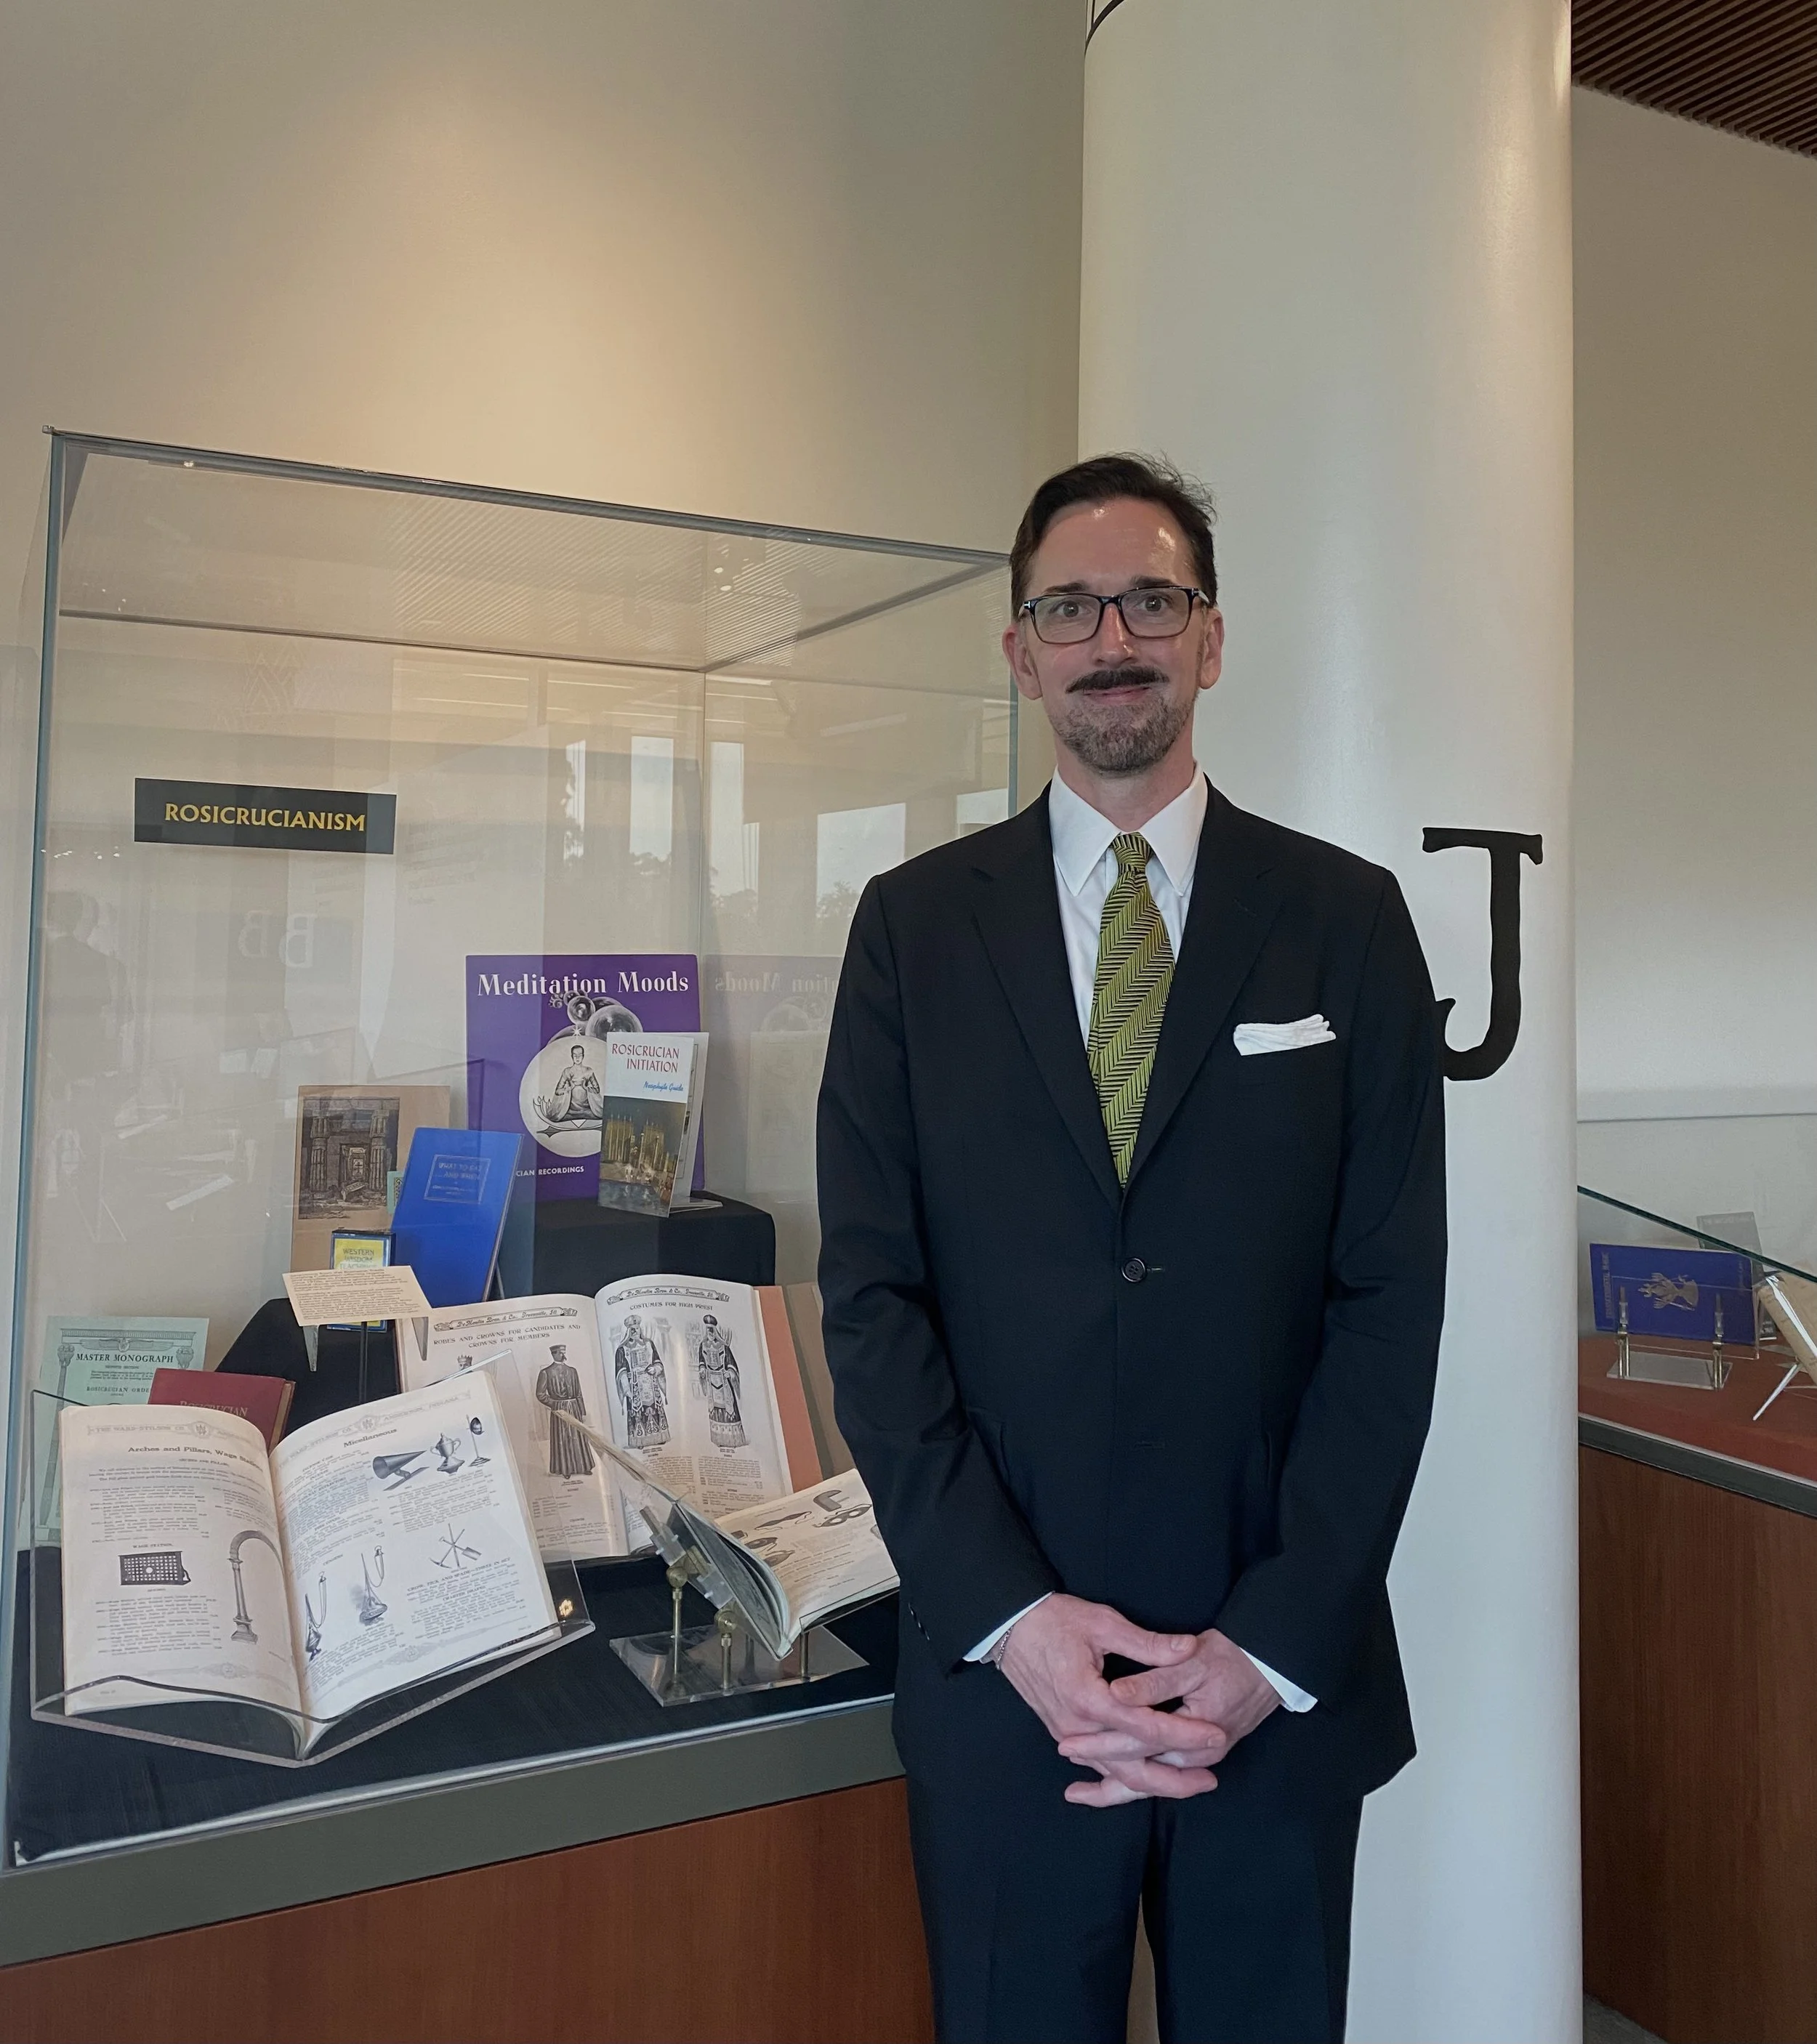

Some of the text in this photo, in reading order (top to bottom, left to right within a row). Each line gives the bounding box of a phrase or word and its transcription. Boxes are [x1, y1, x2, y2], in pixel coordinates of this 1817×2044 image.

[164, 802, 366, 832] ROSICRUCIANISM
[1422, 826, 1544, 1082] J
[478, 971, 689, 996] Meditation Moods
[611, 1043, 680, 1059] ROSICRUCIAN
[627, 1058, 678, 1073] INITIATION
[538, 1166, 584, 1176] RECORDINGS
[630, 1301, 663, 1310] COSTUMES
[468, 1339, 498, 1349] CROWNS
[517, 1332, 550, 1341] MEMBERS
[476, 1330, 506, 1341] CROWNS
[525, 1324, 565, 1333] CANDIDATES
[76, 1353, 174, 1363] MASTER MONOGRAPH
[184, 1446, 212, 1455] Pillars,
[215, 1449, 237, 1460] Wage
